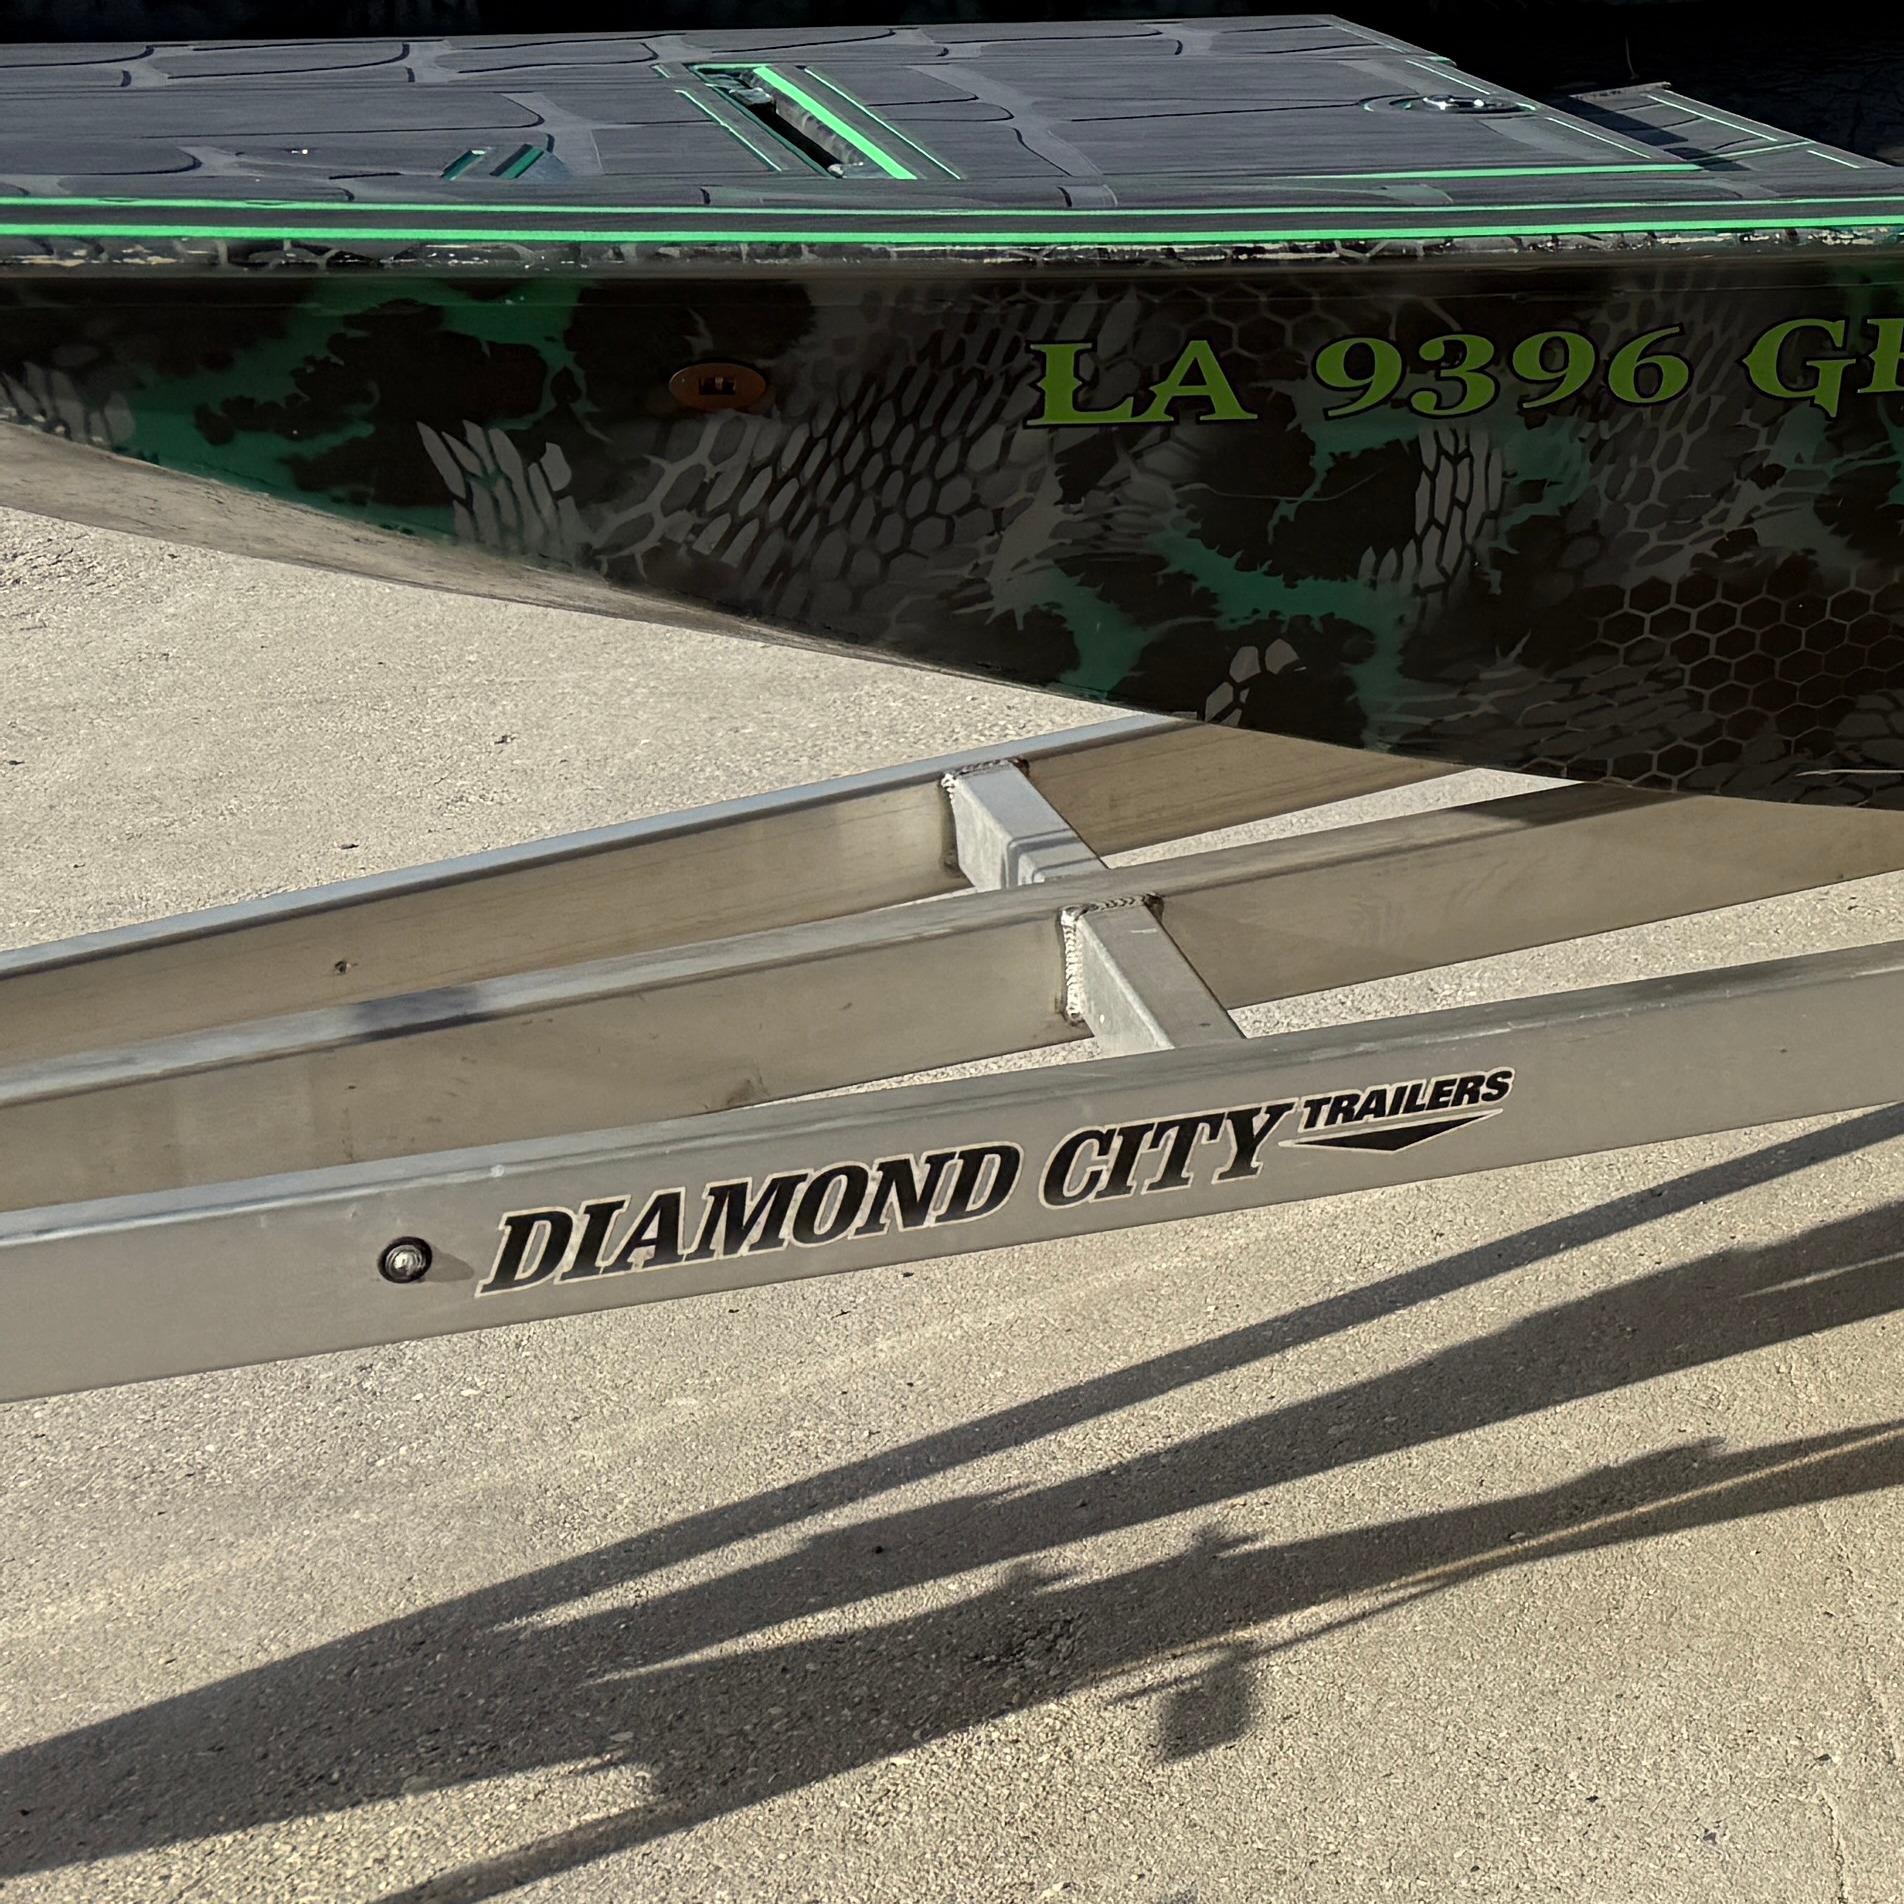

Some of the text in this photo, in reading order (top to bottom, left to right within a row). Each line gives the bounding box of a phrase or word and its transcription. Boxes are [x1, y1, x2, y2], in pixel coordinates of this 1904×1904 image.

[1026, 338, 1258, 427] LA
[1312, 328, 1690, 418] 9396
[474, 1066, 1517, 1297] DIAMOND CITY TRAILERS
